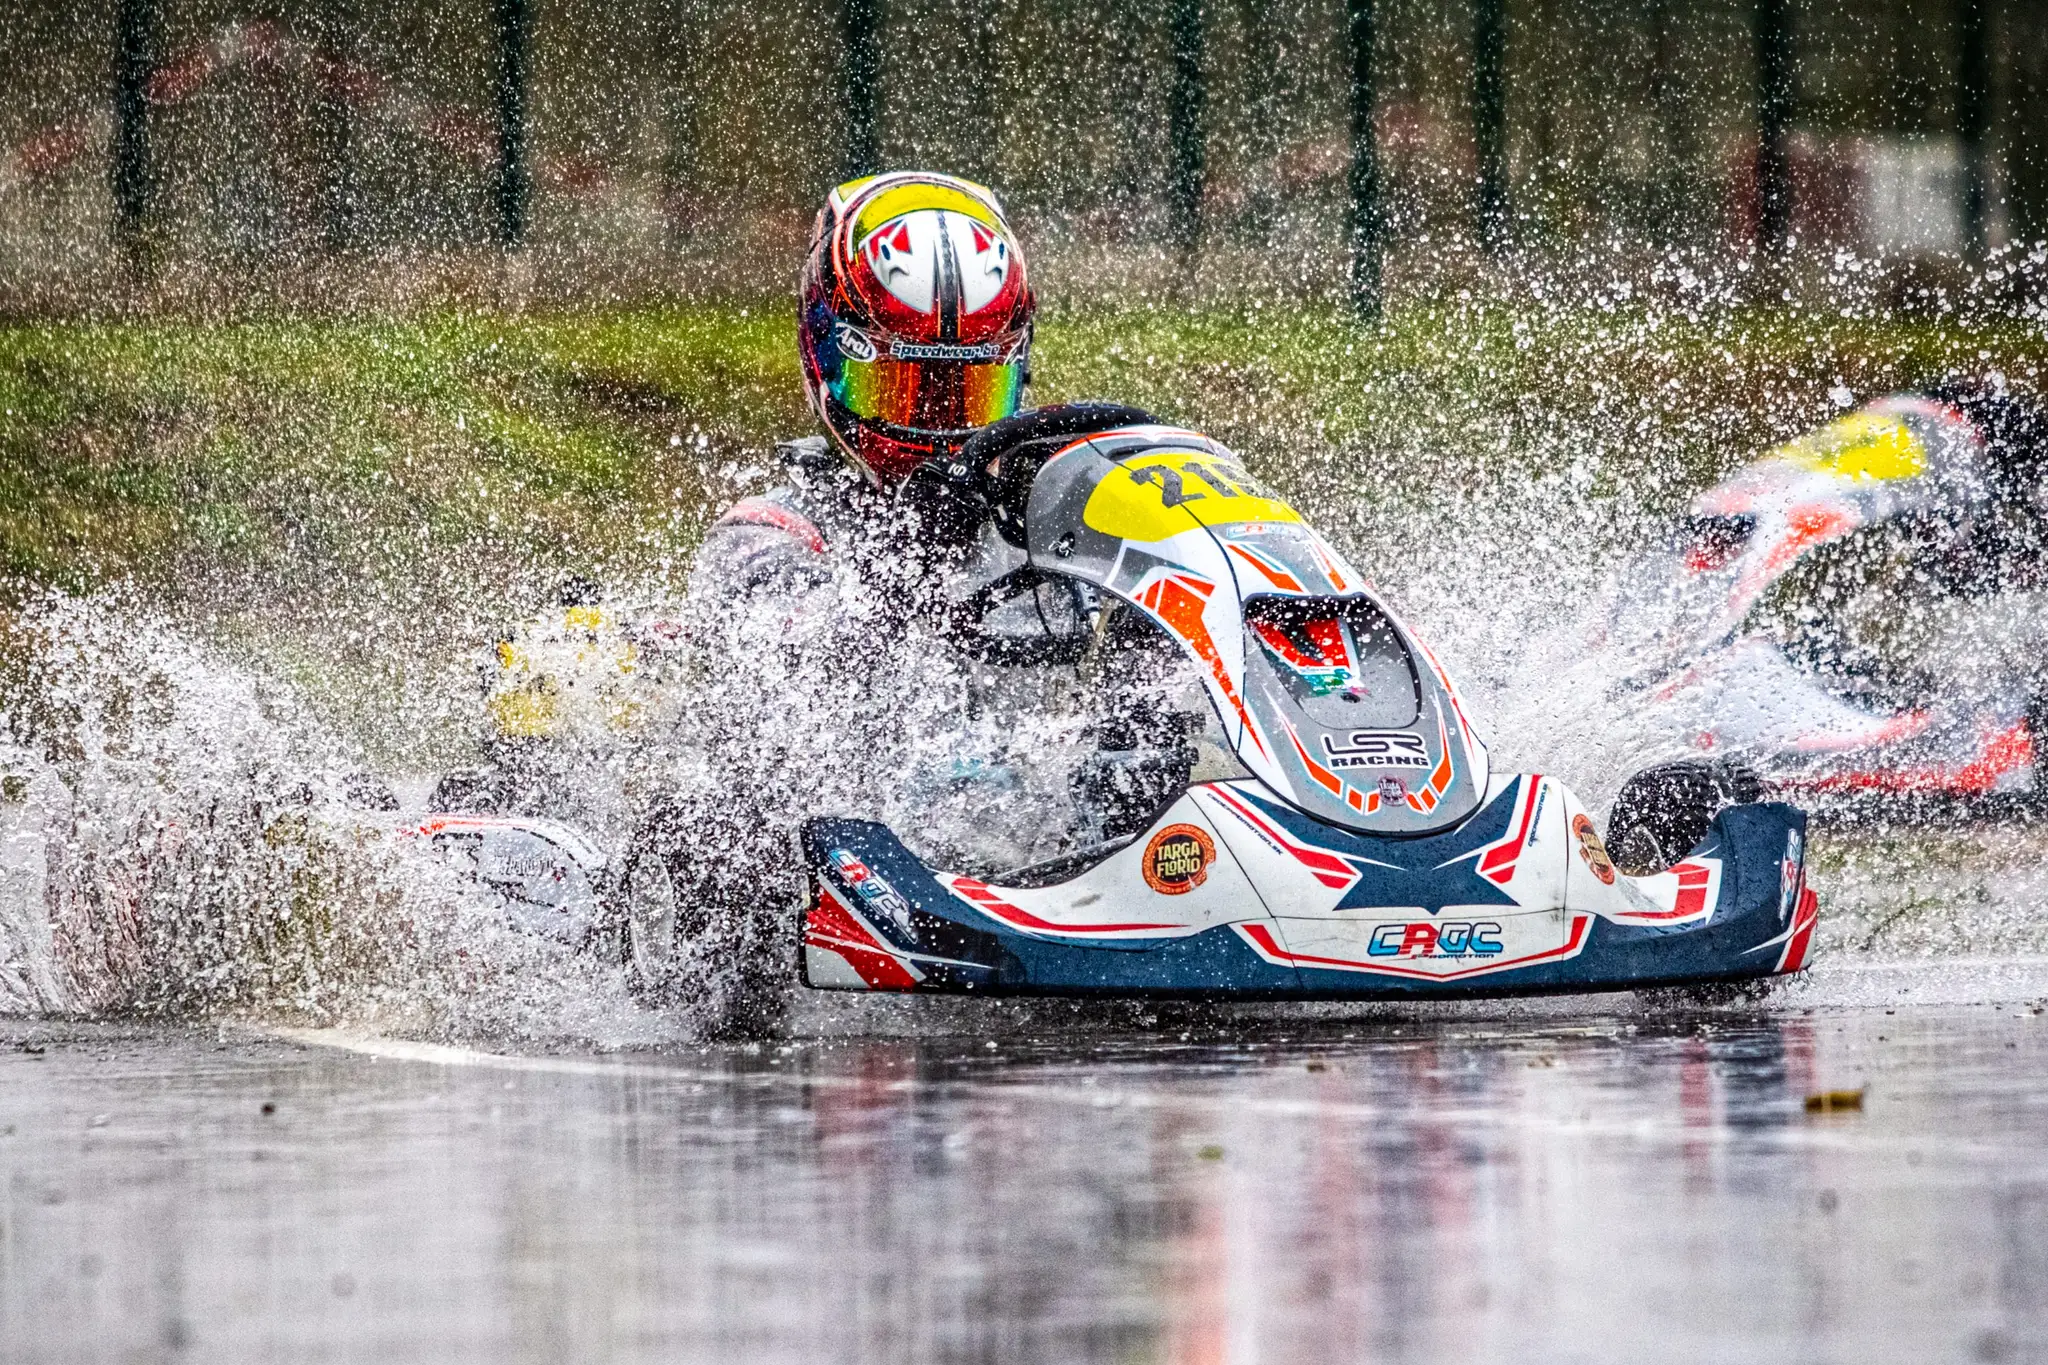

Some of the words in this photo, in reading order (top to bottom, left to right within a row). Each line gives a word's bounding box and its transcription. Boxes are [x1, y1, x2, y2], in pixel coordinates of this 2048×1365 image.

[837, 328, 870, 357] Arai
[890, 341, 1000, 358] Speedwear.be
[1323, 732, 1426, 756] LSR
[1330, 756, 1430, 767] RACING
[1157, 841, 1200, 861] TARGA
[1157, 857, 1201, 878] FLORIO
